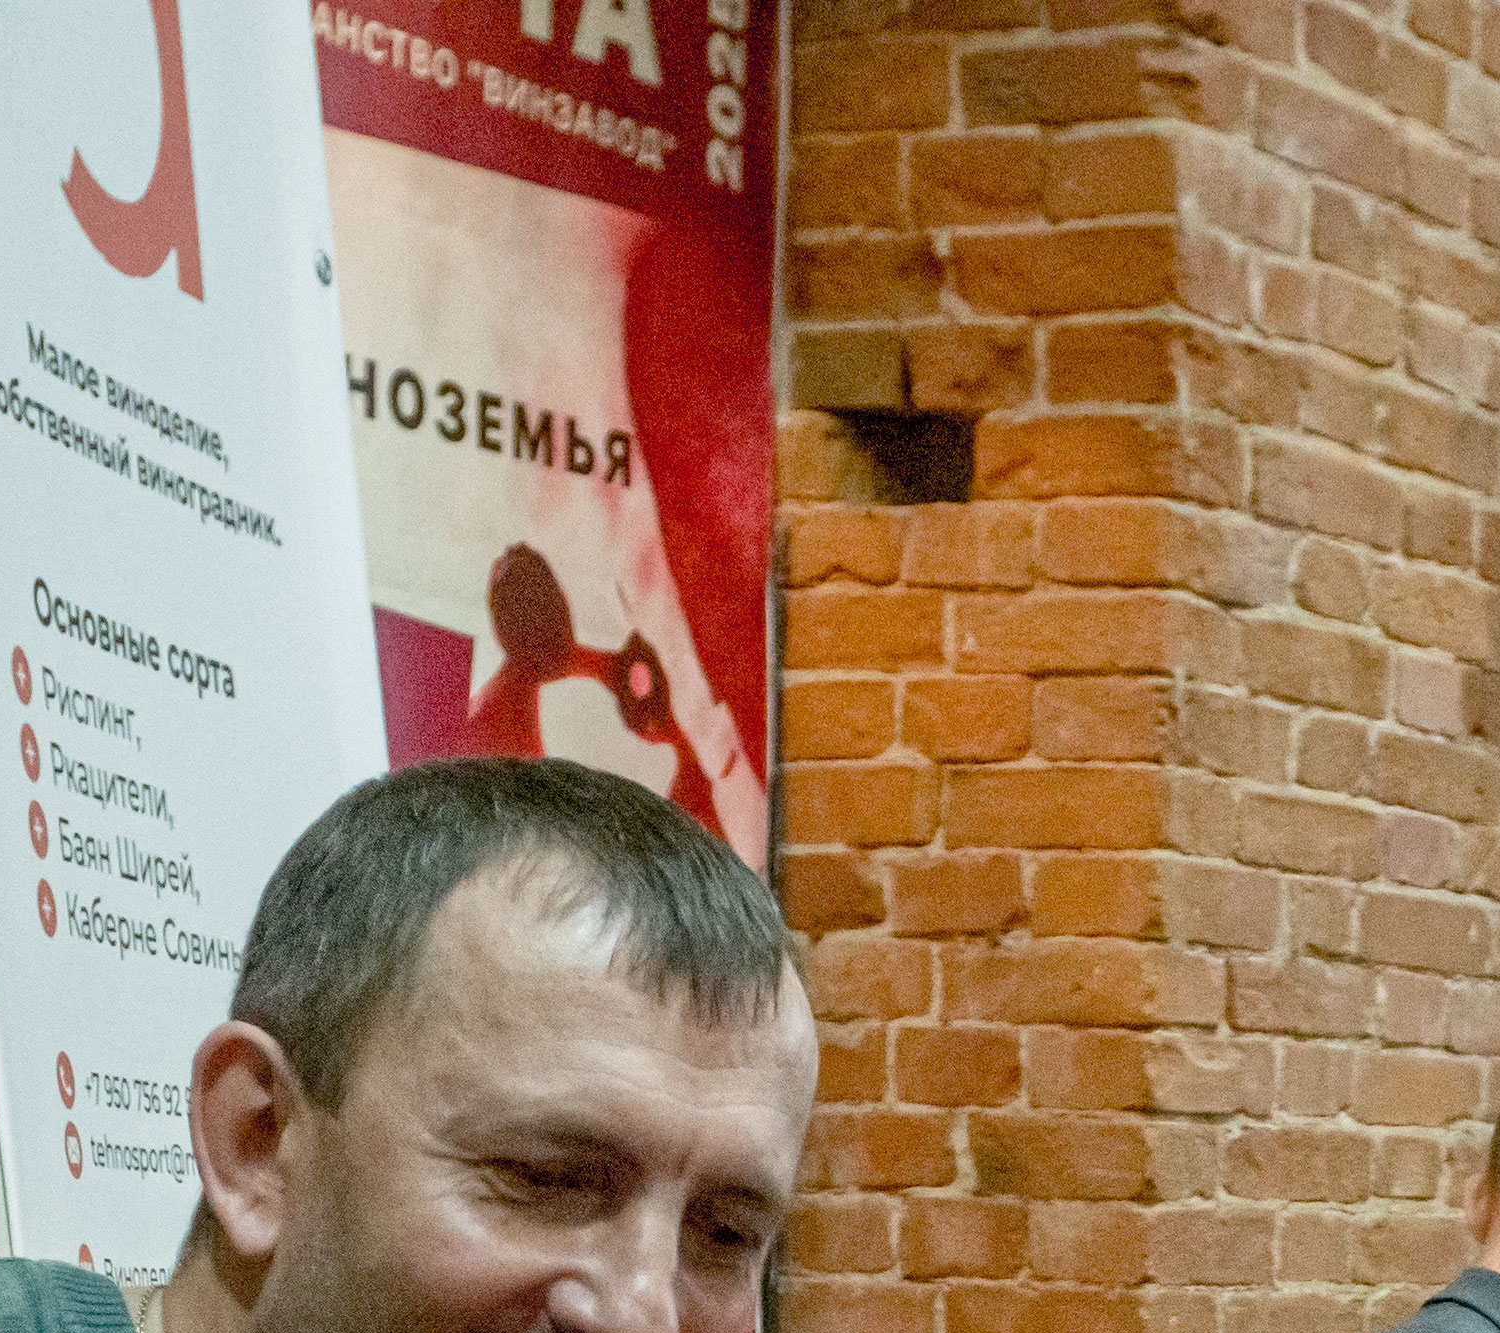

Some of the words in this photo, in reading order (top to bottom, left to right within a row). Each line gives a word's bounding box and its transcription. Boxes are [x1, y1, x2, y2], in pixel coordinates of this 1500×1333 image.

[26, 321, 100, 398] Малое
[106, 375, 229, 473] виноделие,
[345, 353, 631, 487] НОЗЕМЬЯ
[137, 454, 283, 547] виноградник.
[33, 577, 160, 671] Основные
[167, 640, 236, 699] сорта
[41, 666, 142, 751] Рислинг,
[50, 741, 175, 830] Ркацители,
[58, 817, 112, 875] Баян
[116, 836, 200, 905] Ширей,
[67, 892, 157, 961] Каберне
[84, 1071, 100, 1106] +7
[103, 1074, 131, 1111] 950
[133, 1079, 161, 1114] 756
[163, 1083, 182, 1117] 92
